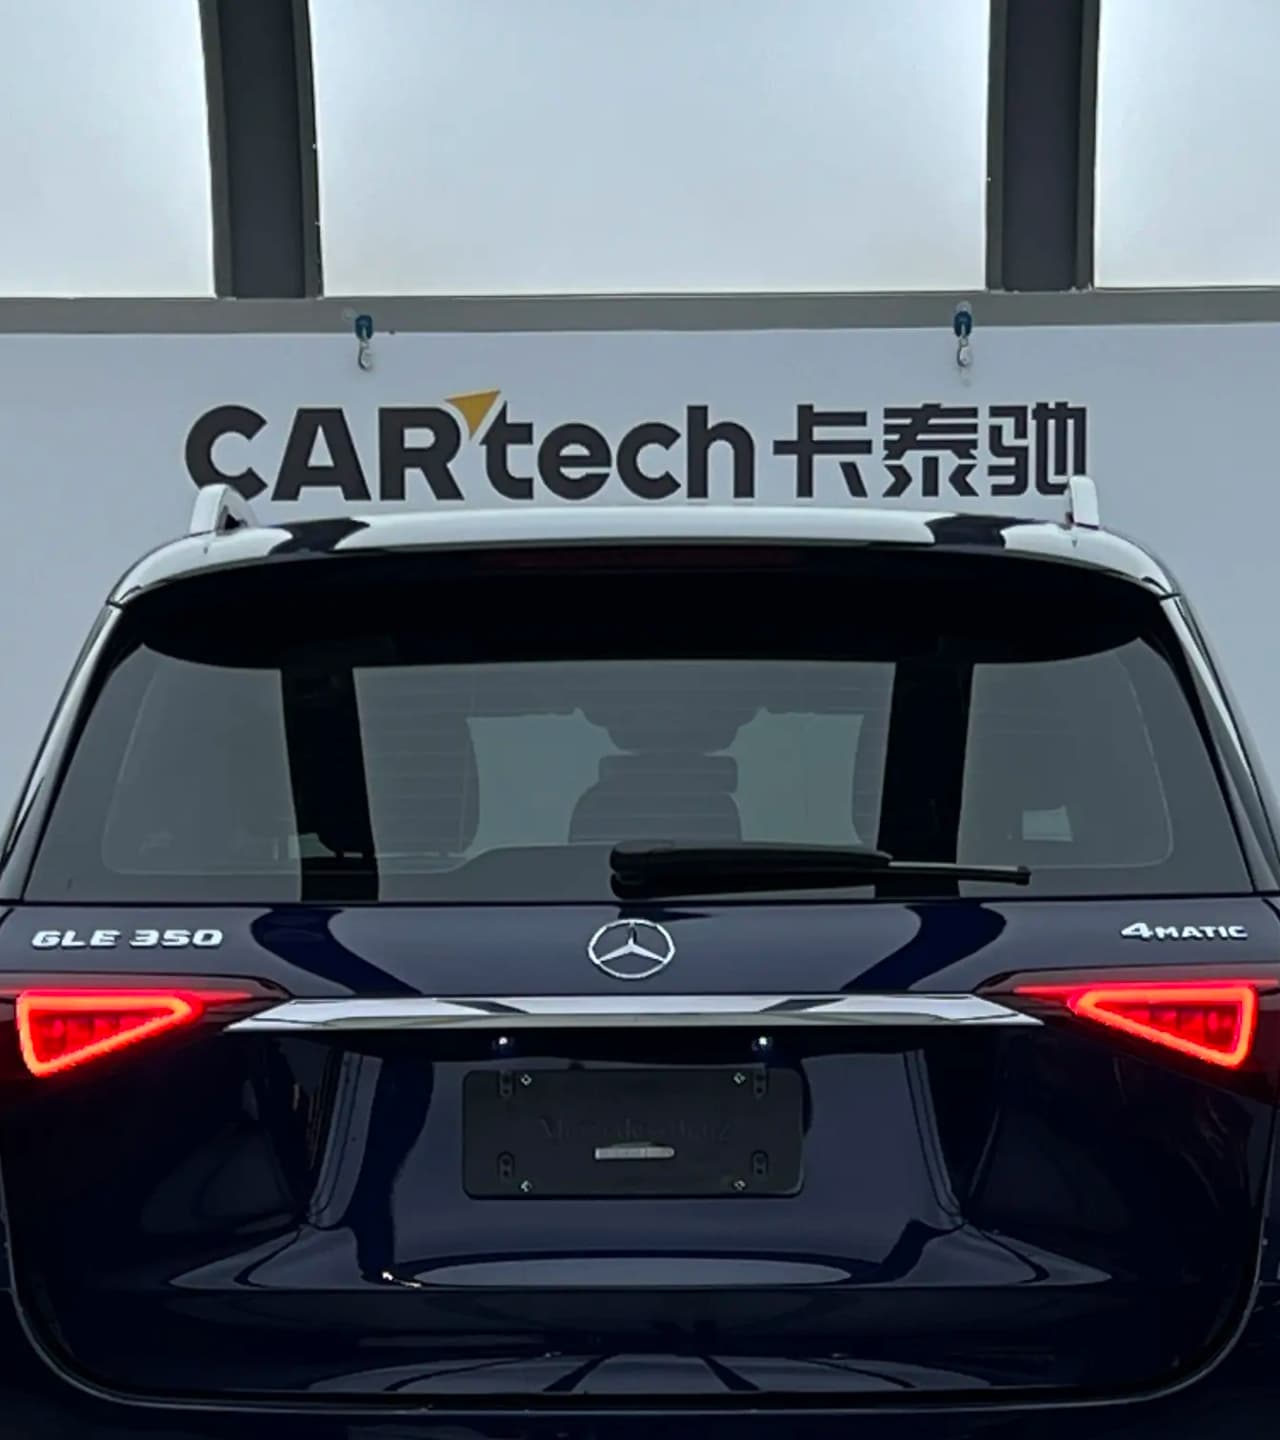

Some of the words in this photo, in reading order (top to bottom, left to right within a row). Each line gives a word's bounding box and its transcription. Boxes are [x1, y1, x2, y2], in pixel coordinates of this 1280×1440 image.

[185, 401, 755, 501] CARtech
[773, 401, 1086, 498] 卡泰驰
[31, 930, 120, 948] GLE
[129, 929, 223, 948] 350
[1120, 922, 1249, 940] 4MATIC
